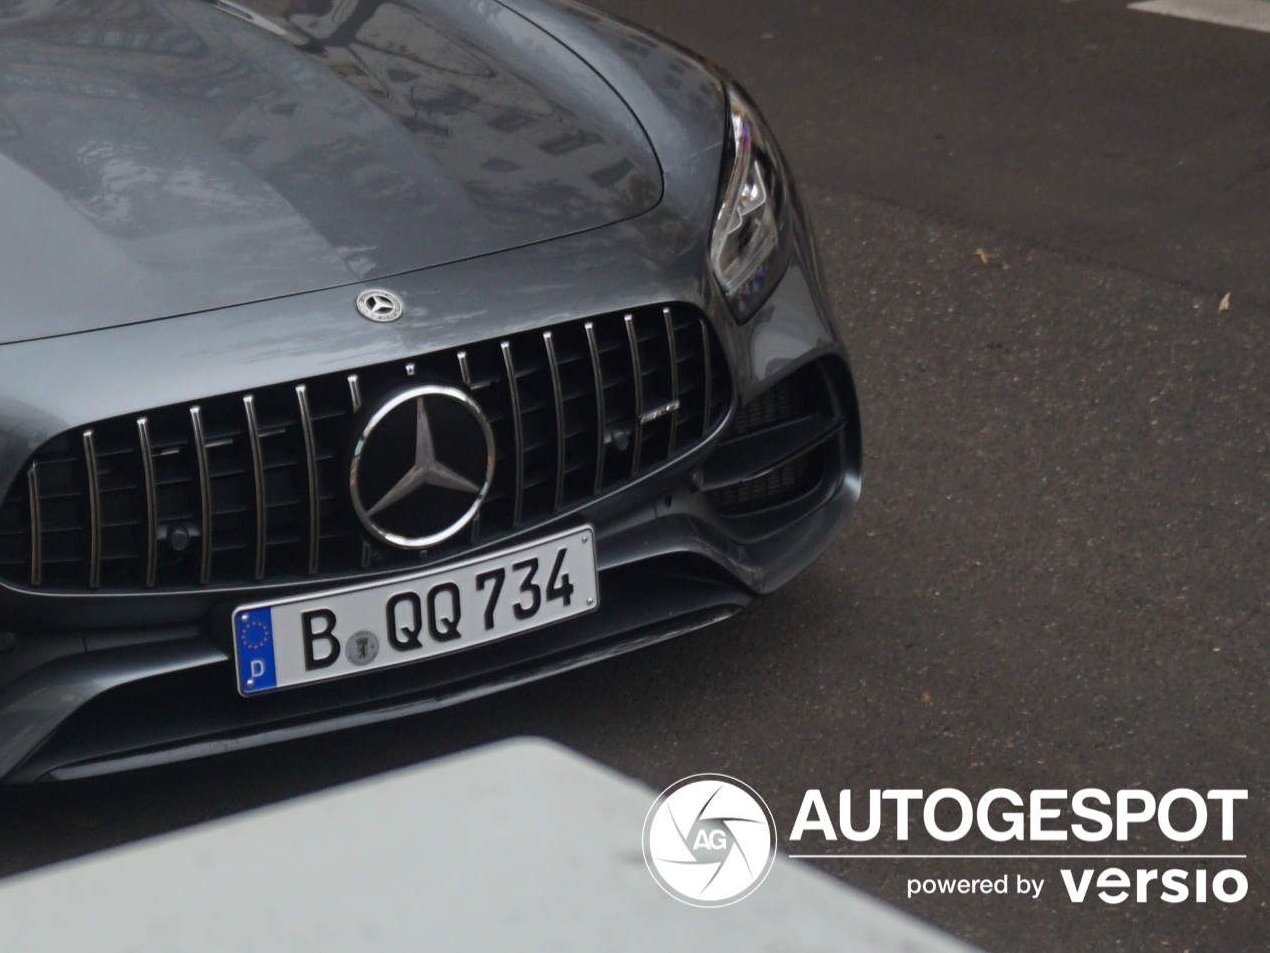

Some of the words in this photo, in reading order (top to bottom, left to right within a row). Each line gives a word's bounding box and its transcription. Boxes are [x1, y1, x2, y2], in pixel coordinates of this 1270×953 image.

[301, 607, 341, 672] B
[385, 582, 462, 653] QQ
[475, 547, 575, 631] 734
[250, 658, 266, 678] D
